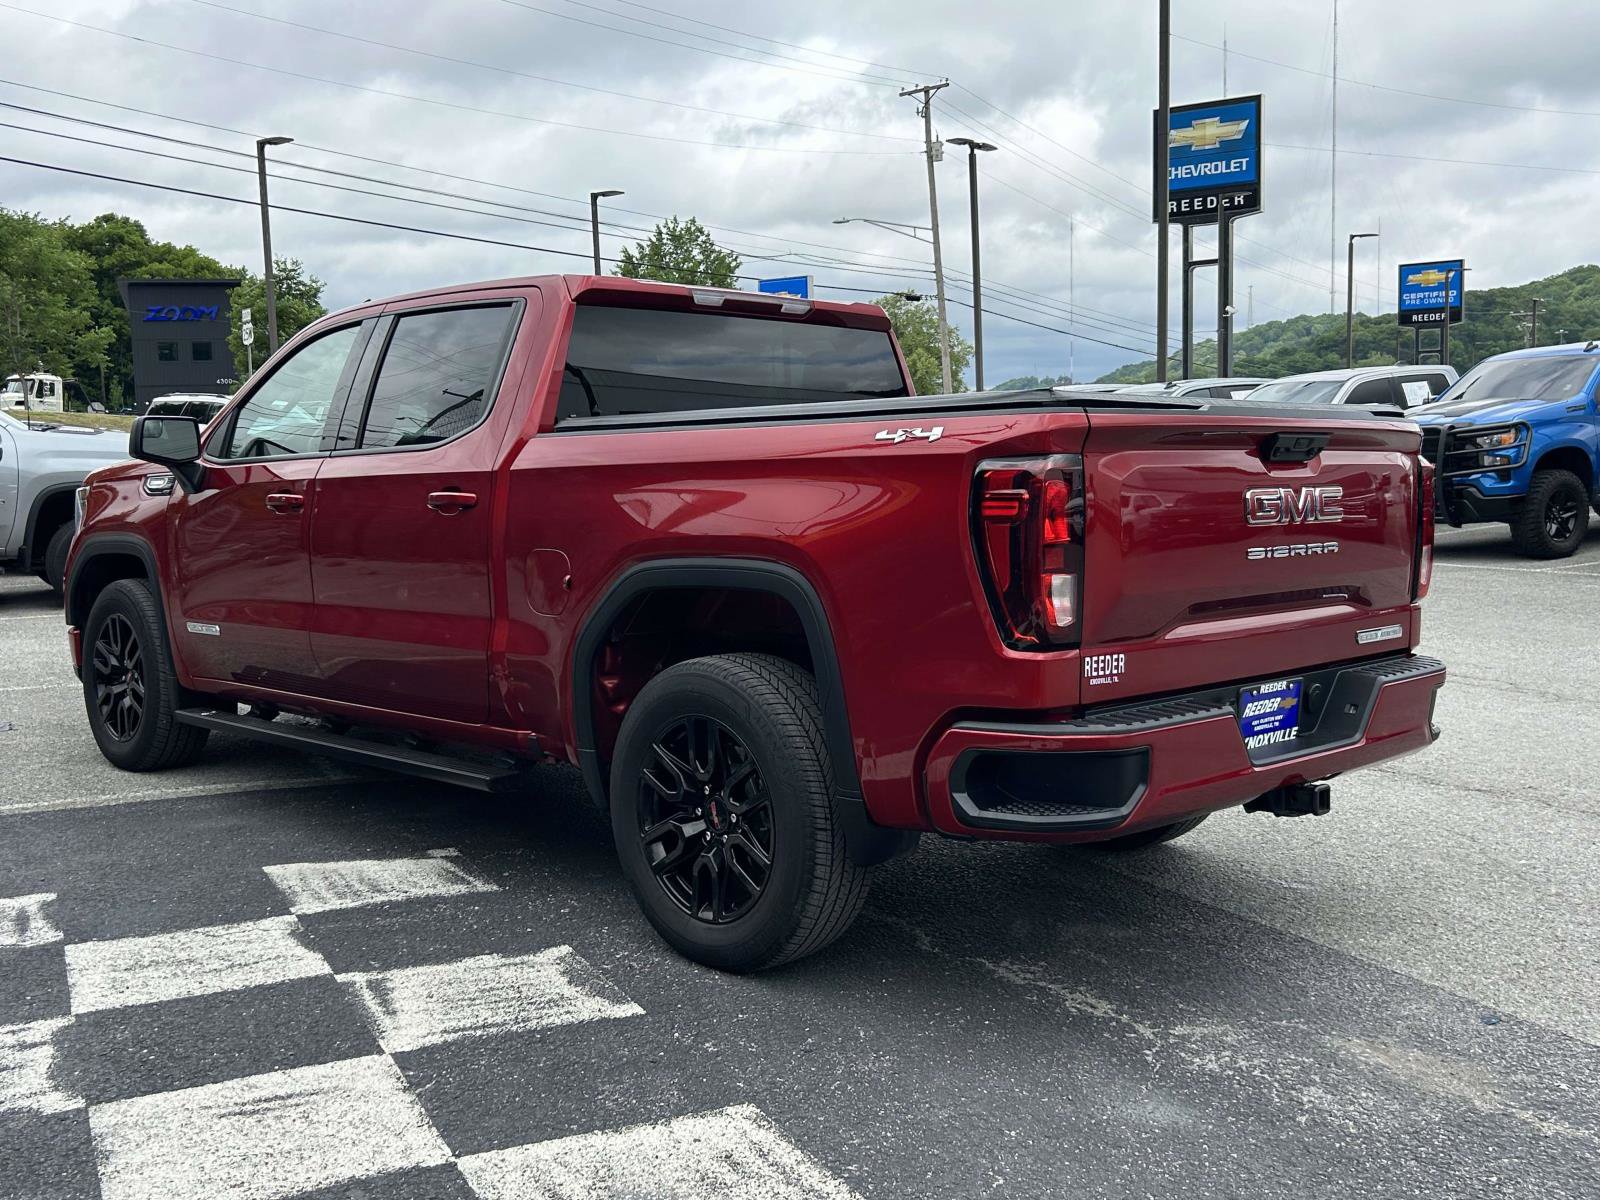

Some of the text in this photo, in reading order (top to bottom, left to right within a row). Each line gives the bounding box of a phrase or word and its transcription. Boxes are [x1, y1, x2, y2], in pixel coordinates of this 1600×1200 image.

[1405, 297, 1454, 305] PRE-OWND
[1245, 486, 1344, 526] GMC
[1247, 541, 1339, 560] SIERRA
[1084, 653, 1125, 677] REEDER
[1260, 681, 1287, 694] REEDER
[1242, 697, 1281, 718] REEDER
[1245, 726, 1298, 749] NOXVILLE
